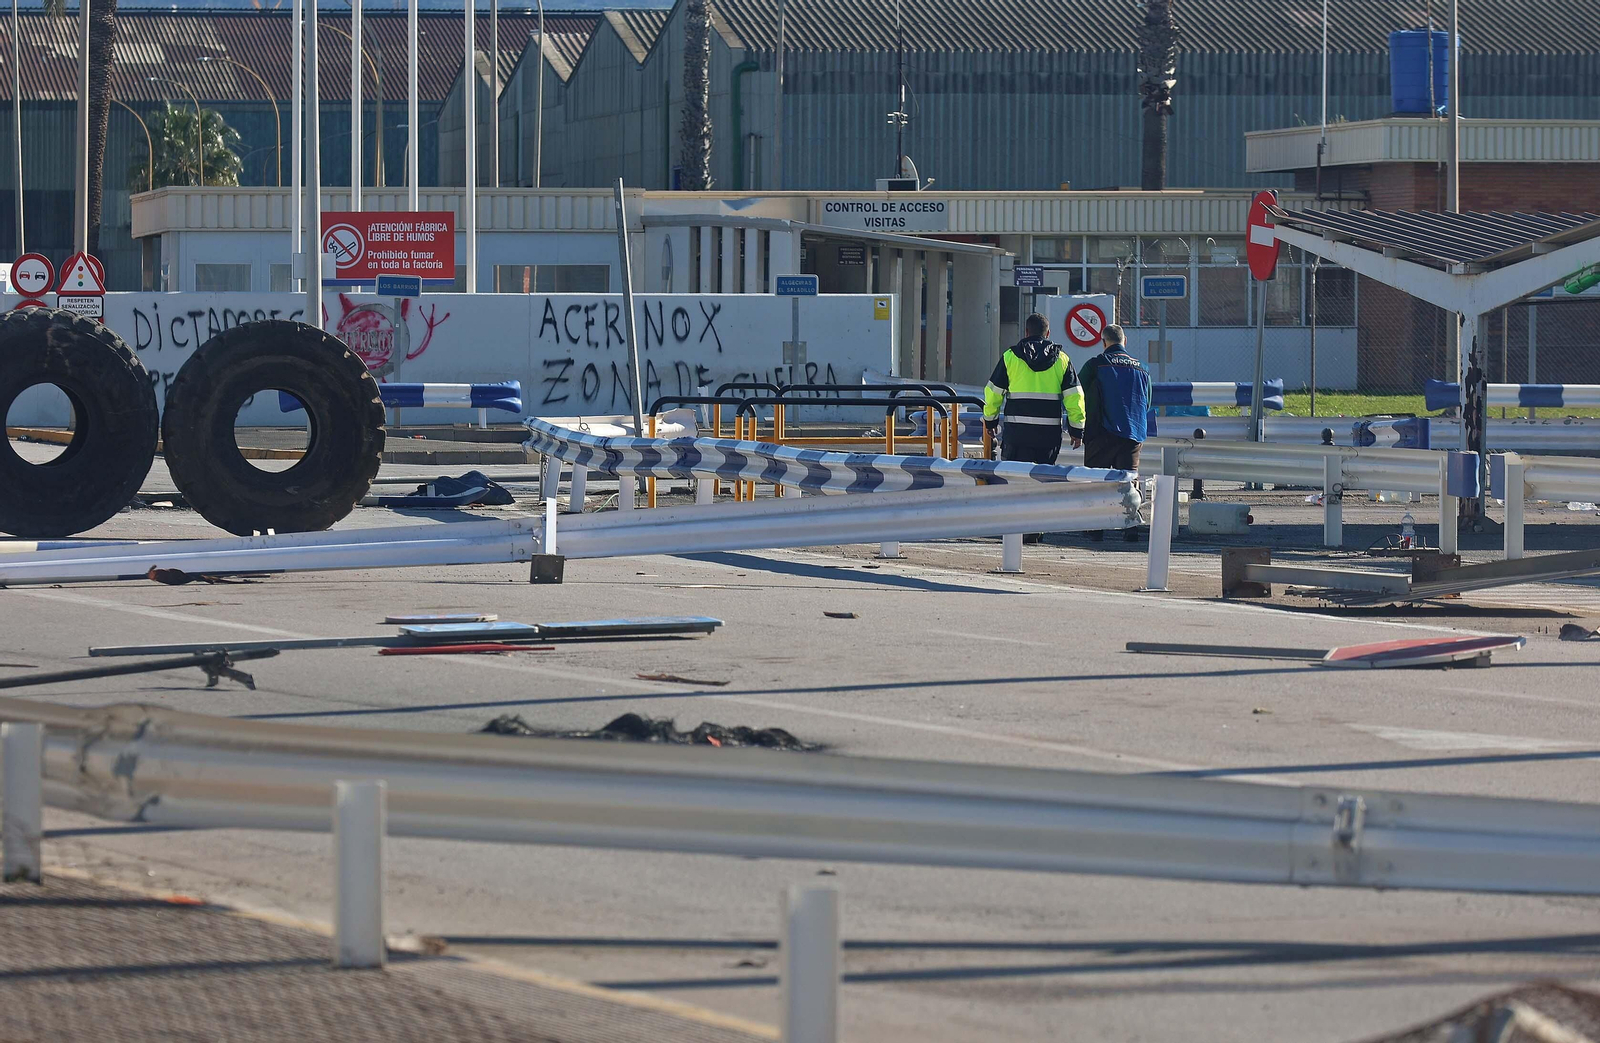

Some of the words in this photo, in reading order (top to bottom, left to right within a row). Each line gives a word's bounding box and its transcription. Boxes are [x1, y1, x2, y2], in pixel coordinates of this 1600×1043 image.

[825, 202, 878, 213] CONTROL
[882, 202, 896, 212] DE
[899, 202, 945, 213] ACCESO
[864, 217, 906, 227] VISITAS
[367, 221, 413, 234] ¡ATENCIÓN!
[415, 221, 448, 232] FÁBRICA
[367, 232, 391, 242] LIBRE
[393, 232, 405, 242] DE
[406, 232, 435, 242] HUMOS
[367, 250, 408, 259] Prohibido
[410, 250, 435, 259] fumar
[367, 261, 378, 269] en
[381, 260, 400, 269] toda
[402, 260, 411, 269] la
[413, 259, 443, 269] factoría
[538, 297, 722, 353] ACERNOX
[1111, 357, 1141, 367] elecnor
